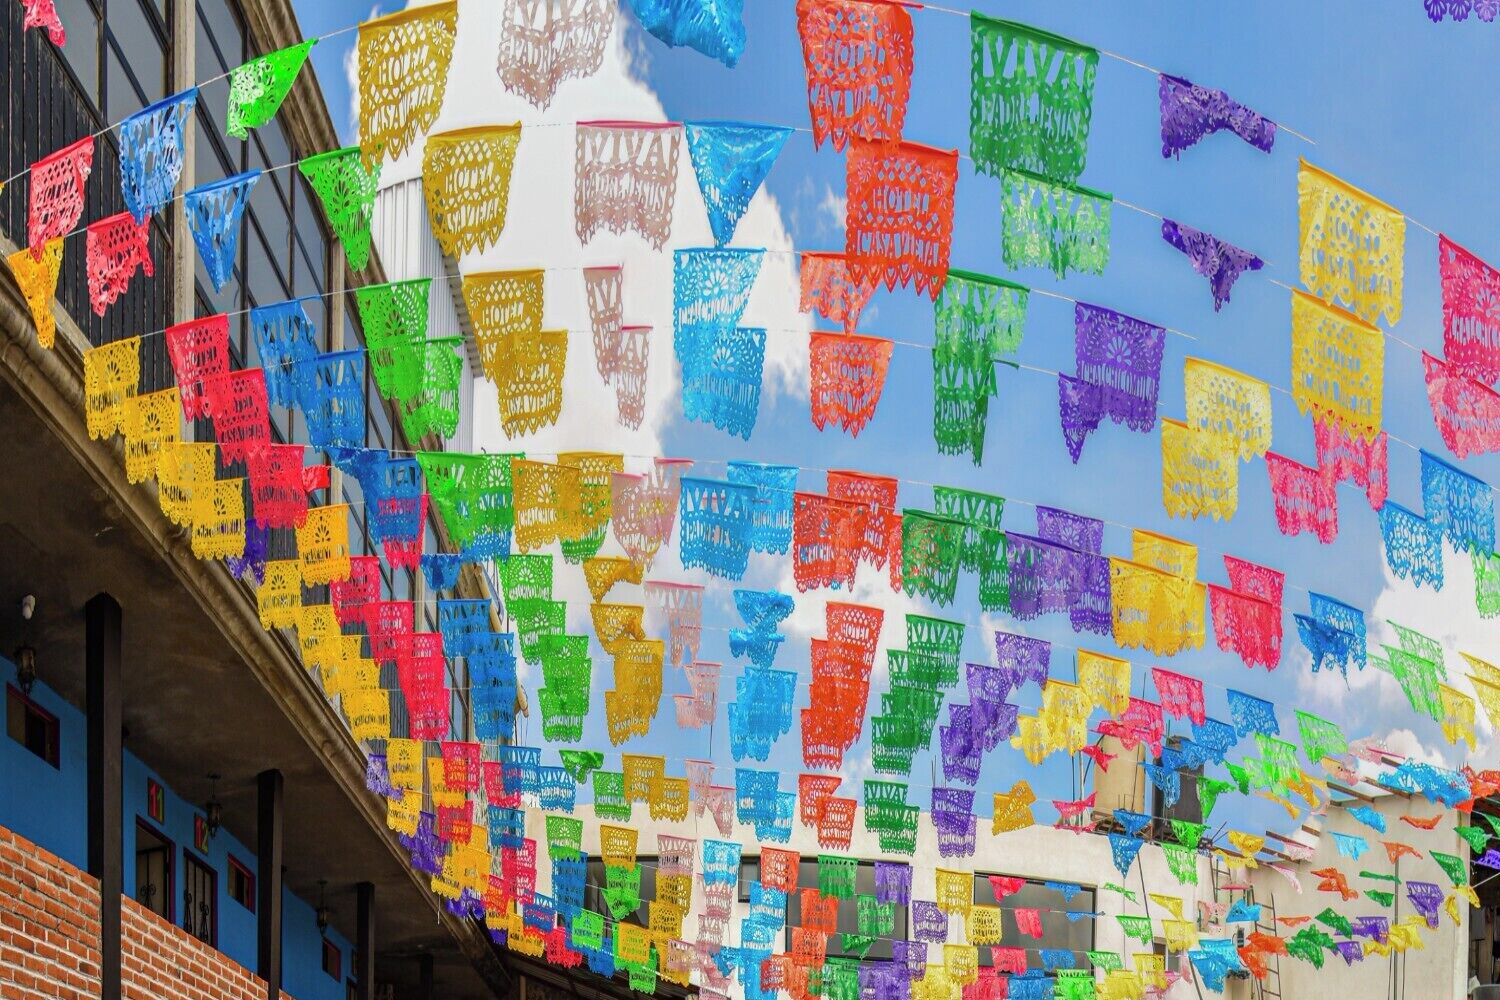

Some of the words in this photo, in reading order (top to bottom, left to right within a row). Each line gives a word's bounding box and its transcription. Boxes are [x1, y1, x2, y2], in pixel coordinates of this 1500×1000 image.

[378, 43, 430, 86] HOTEL
[982, 34, 1087, 94] VIVA
[584, 130, 671, 171] VIVA
[444, 162, 494, 195] HOTEL
[872, 186, 930, 214] HOTEL
[857, 229, 896, 257] CASA
[899, 230, 940, 267] VIEJA
[482, 302, 524, 327] HOTEL
[840, 622, 870, 641] HOTEL
[910, 622, 962, 645] VIVA
[149, 782, 164, 824] 11
[867, 783, 905, 800] VIVA
[195, 815, 209, 855] 12
